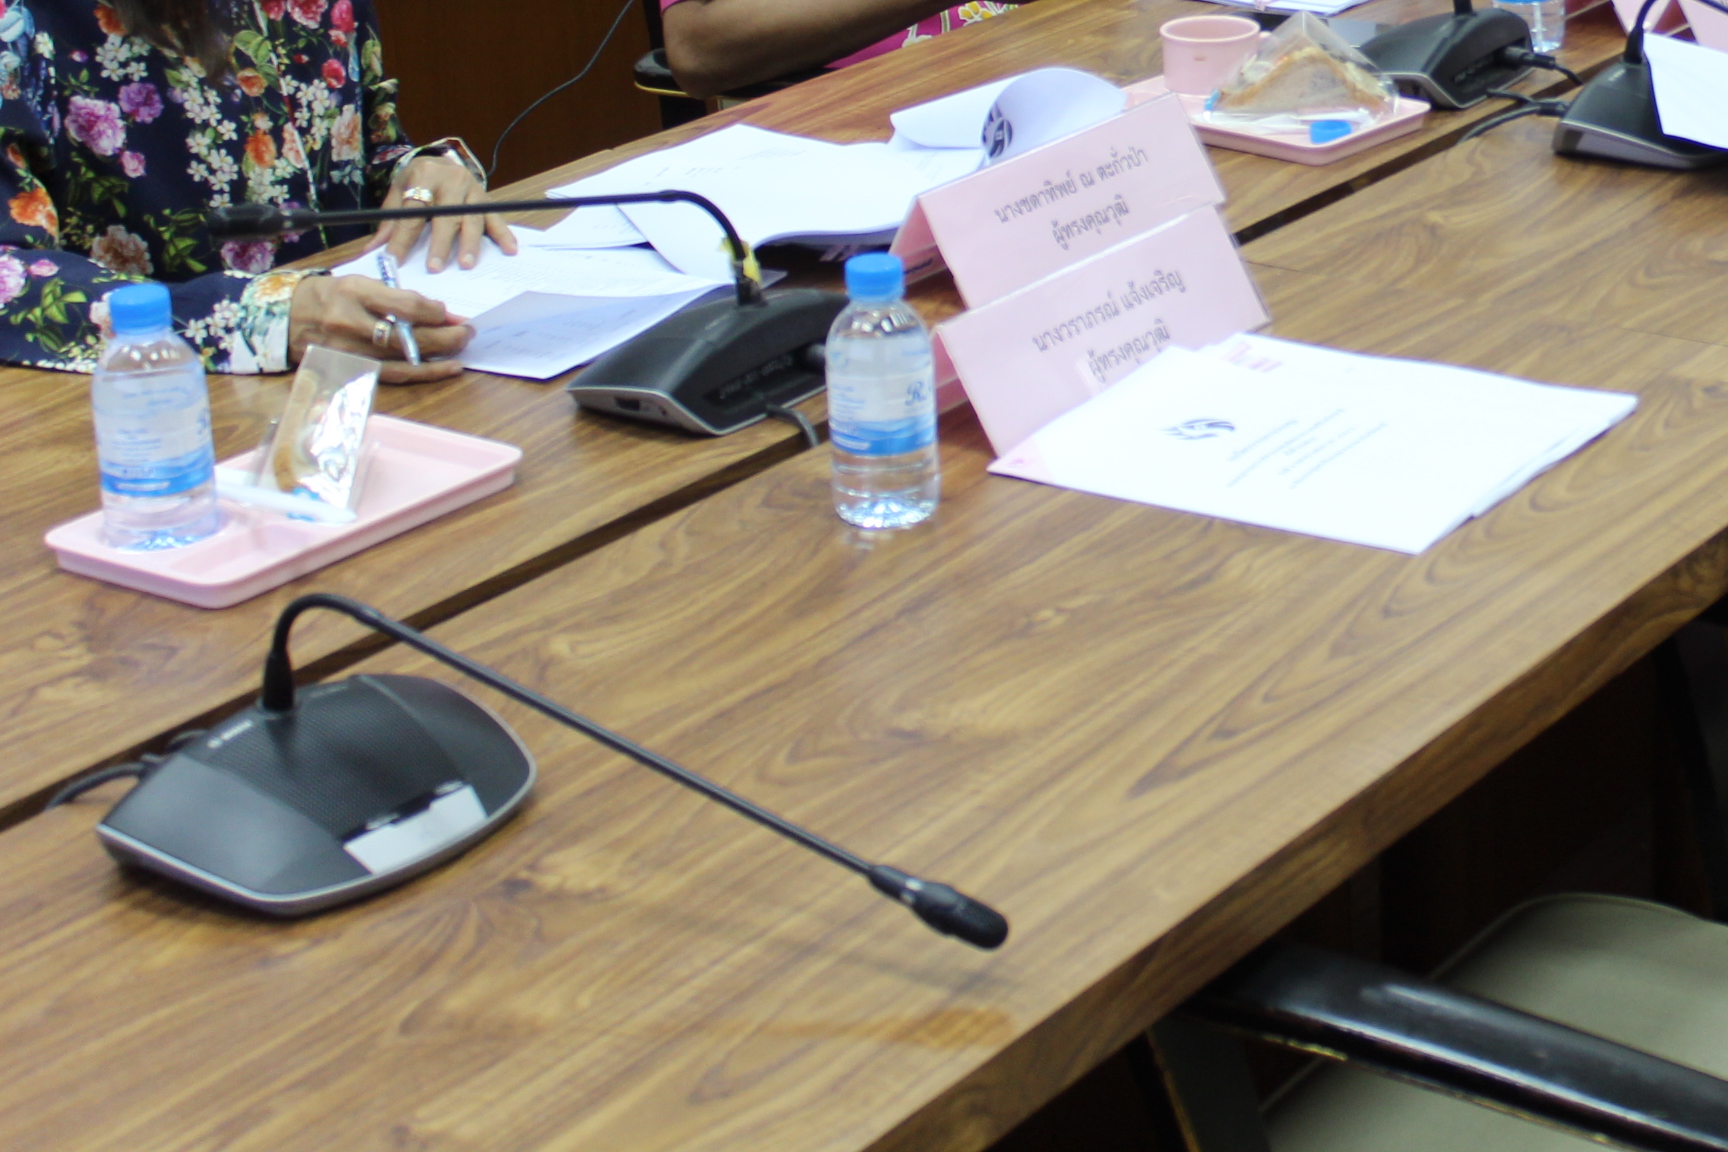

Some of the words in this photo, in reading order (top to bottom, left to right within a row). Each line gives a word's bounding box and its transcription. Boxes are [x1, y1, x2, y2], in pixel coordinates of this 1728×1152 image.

[1052, 193, 1130, 250] ผู้ทรงคุณวุฒิ
[1031, 290, 1120, 353] นางวราภรณ์
[1120, 269, 1186, 310] แจ้งเจริญ
[1087, 318, 1171, 383] ผู้ทรงคุณวุฒิ
